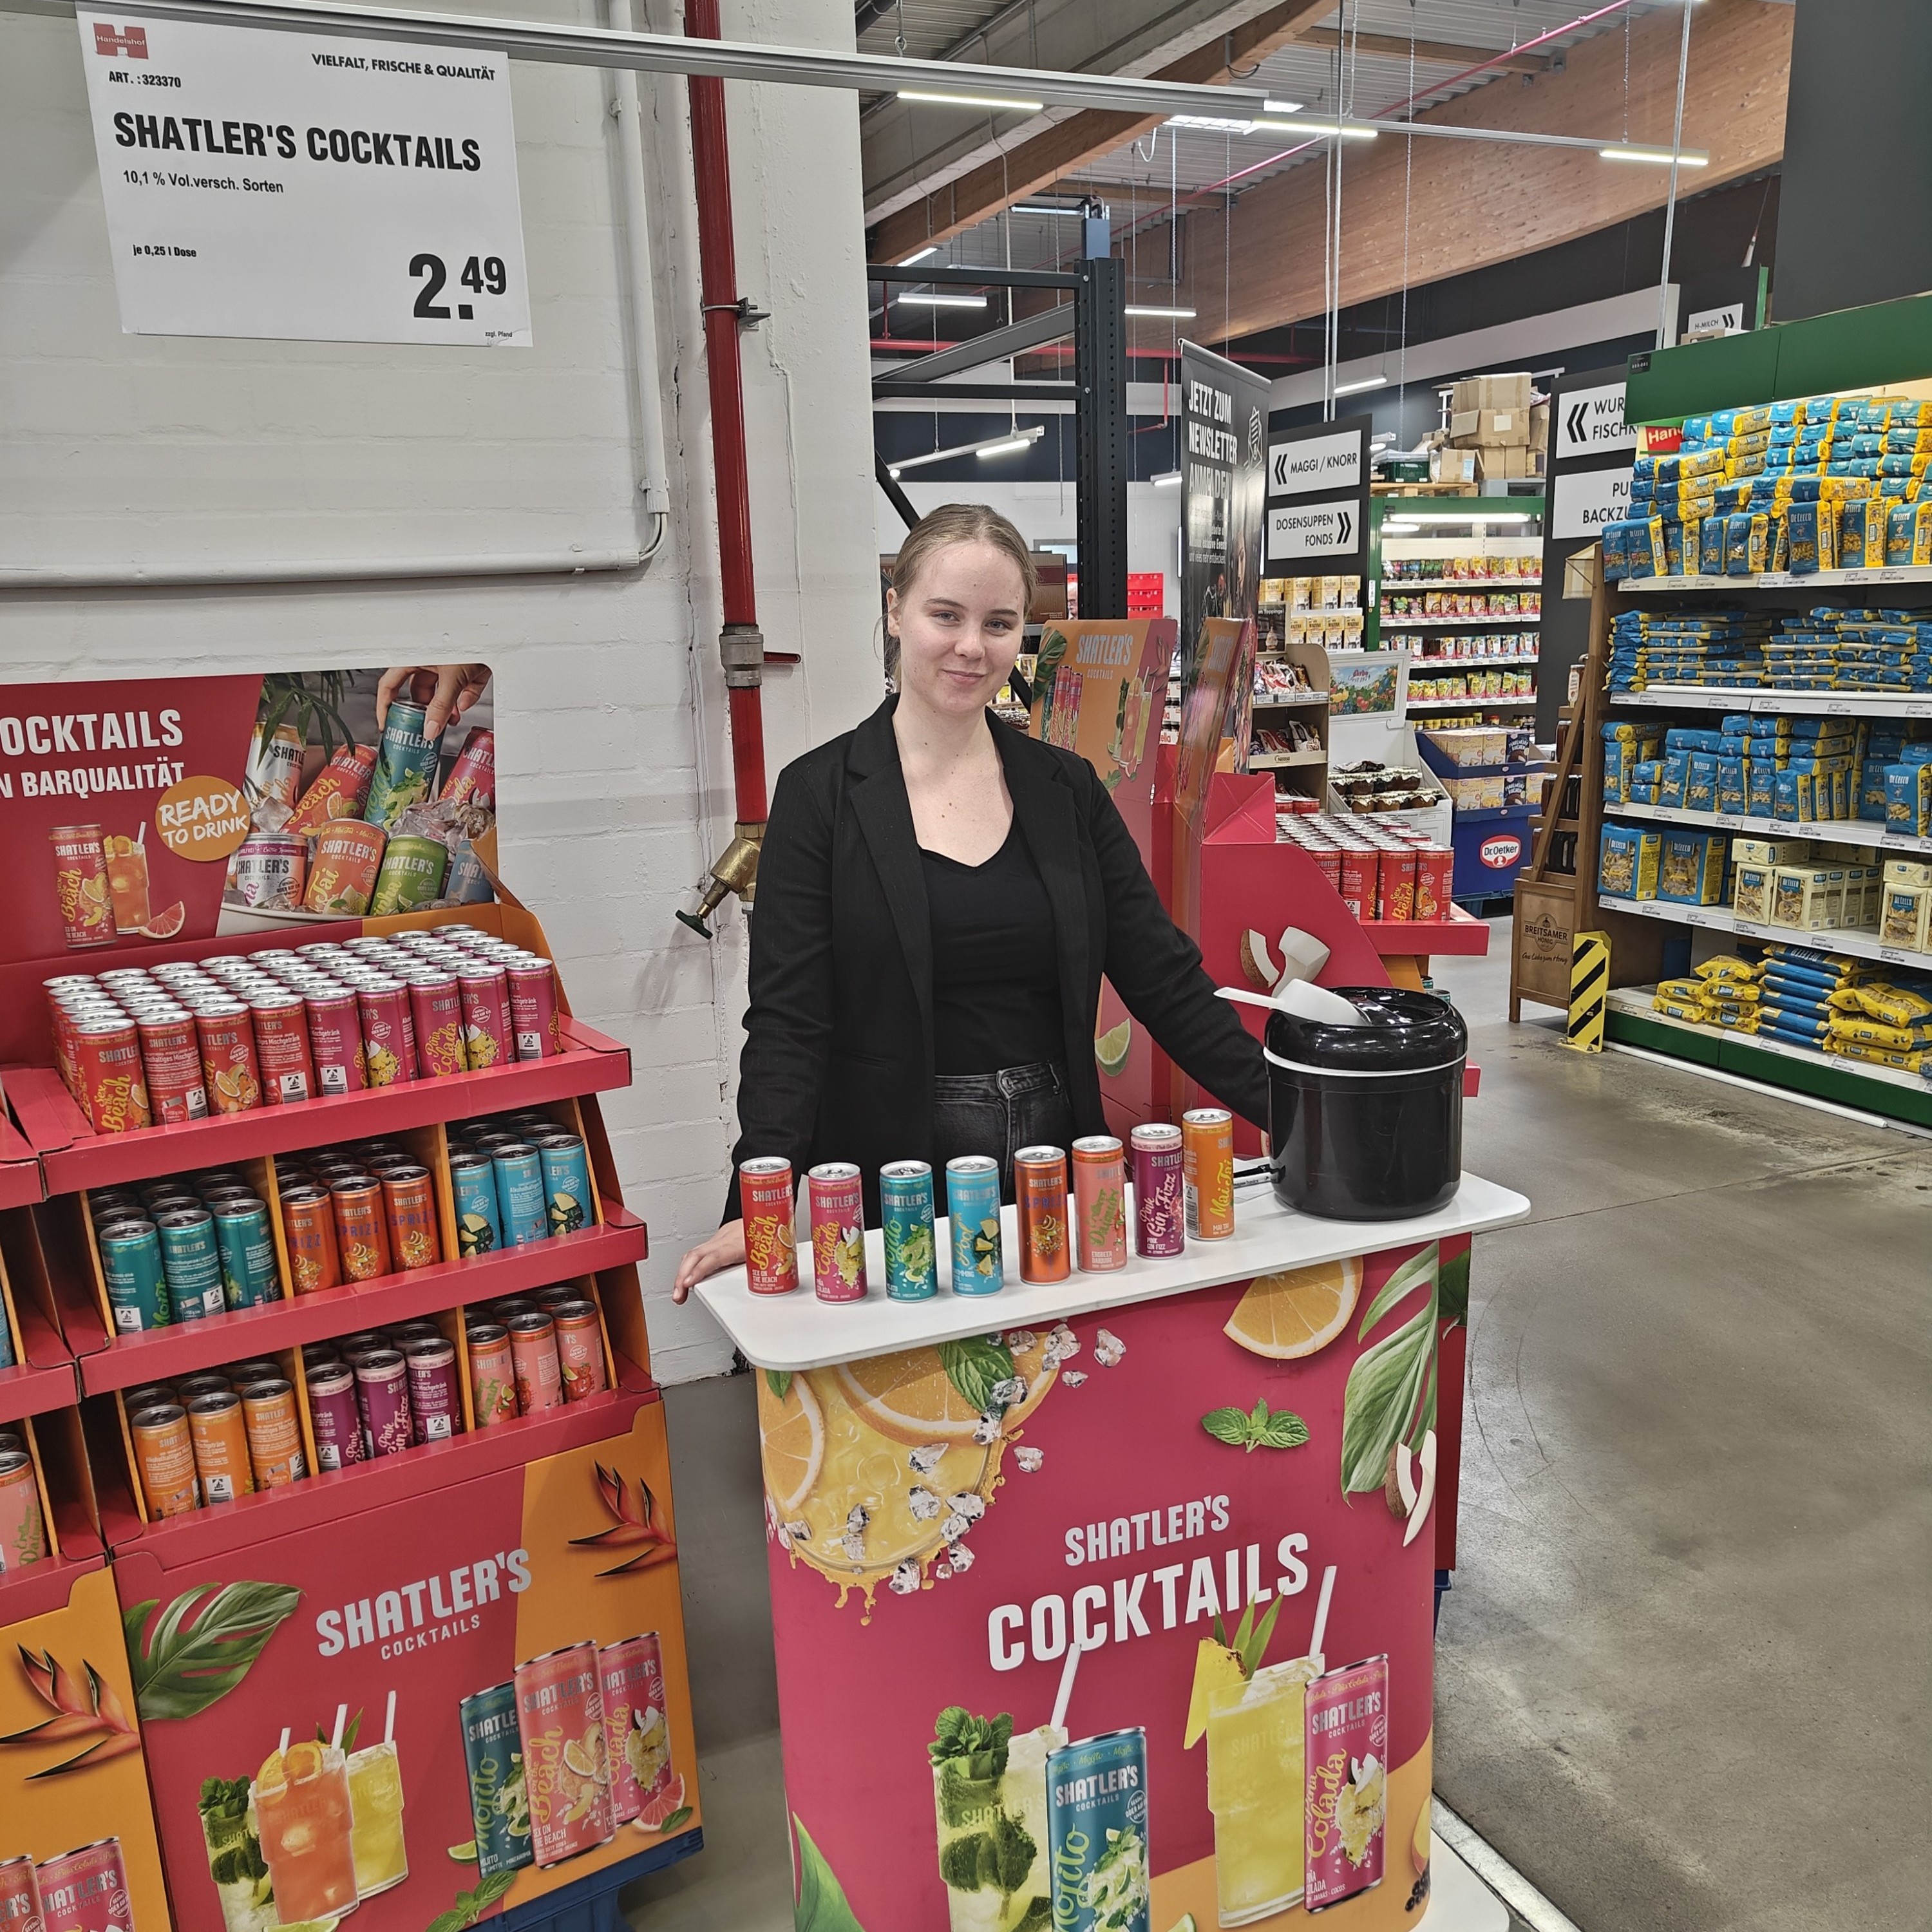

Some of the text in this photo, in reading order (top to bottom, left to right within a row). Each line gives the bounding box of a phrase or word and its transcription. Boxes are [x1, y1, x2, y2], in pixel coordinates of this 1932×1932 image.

[96, 35, 145, 46] Handelshof
[109, 71, 134, 84] ART.
[312, 53, 495, 80] VIELFALT, FRISCHE & QUALITÄT
[114, 111, 480, 171] SHATLER'S COCKTAILS
[123, 170, 150, 186] 10,1
[153, 173, 166, 185] %
[243, 177, 283, 193] Sorten
[133, 244, 142, 256] je
[144, 245, 166, 258] 0,25
[174, 247, 196, 258] Dose
[1694, 319, 1718, 330] H-MILCH
[1188, 380, 1231, 424] JETZT ZUM
[1189, 421, 1238, 465] NEWSLETTER
[1291, 453, 1357, 474] MAGGI / KNORR
[1276, 514, 1334, 531] DOSENSUPPEN
[1305, 532, 1333, 547] FONDS
[1076, 633, 1133, 666] SHATLER'S
[23, 757, 185, 799] BARQUALITÄT
[160, 789, 241, 826] READY
[166, 813, 249, 849] TO DRINK
[55, 842, 100, 857] SHATLER'S
[321, 840, 377, 862] SHATLER'S
[332, 853, 361, 864] COCKTAILS
[60, 868, 82, 922] Beach
[1525, 925, 1567, 940] BREITSAMER
[149, 1035, 187, 1048] SHATLER'S
[95, 1084, 106, 1107] Sex
[101, 1074, 131, 1133] Beach
[1029, 1176, 1062, 1188] SHATLER'S
[1156, 1173, 1176, 1210] Fizz
[393, 1193, 427, 1207] SHATLER'S
[815, 1193, 859, 1208] SHATLER'S
[884, 1193, 927, 1207] SHATLER'S
[1140, 1197, 1155, 1222] Pink
[1209, 1188, 1229, 1218] Mai
[747, 1221, 756, 1242] Sex
[1146, 1212, 1168, 1237] Gin
[750, 1214, 779, 1270] Beach
[815, 1221, 840, 1276] Colada
[378, 1422, 394, 1448] Pink
[1065, 1495, 1229, 1566] SHATLER'S
[316, 1548, 532, 1657] SHATLER'S
[988, 1533, 1309, 1671] COCKTAILS
[381, 1614, 481, 1660] COCKTAILS
[524, 1672, 594, 1713] SHATLER'S
[1312, 1691, 1381, 1735] SHATLER'S
[1329, 1719, 1365, 1738] COCKTAILS
[528, 1725, 564, 1824] Beach
[1056, 1765, 1138, 1808] SHATLER'S
[1075, 1794, 1119, 1812] COCKTAILS
[1307, 1748, 1347, 1865] Colada
[544, 1828, 566, 1845] BEACH
[57, 1895, 100, 1918] COCKTAILS
